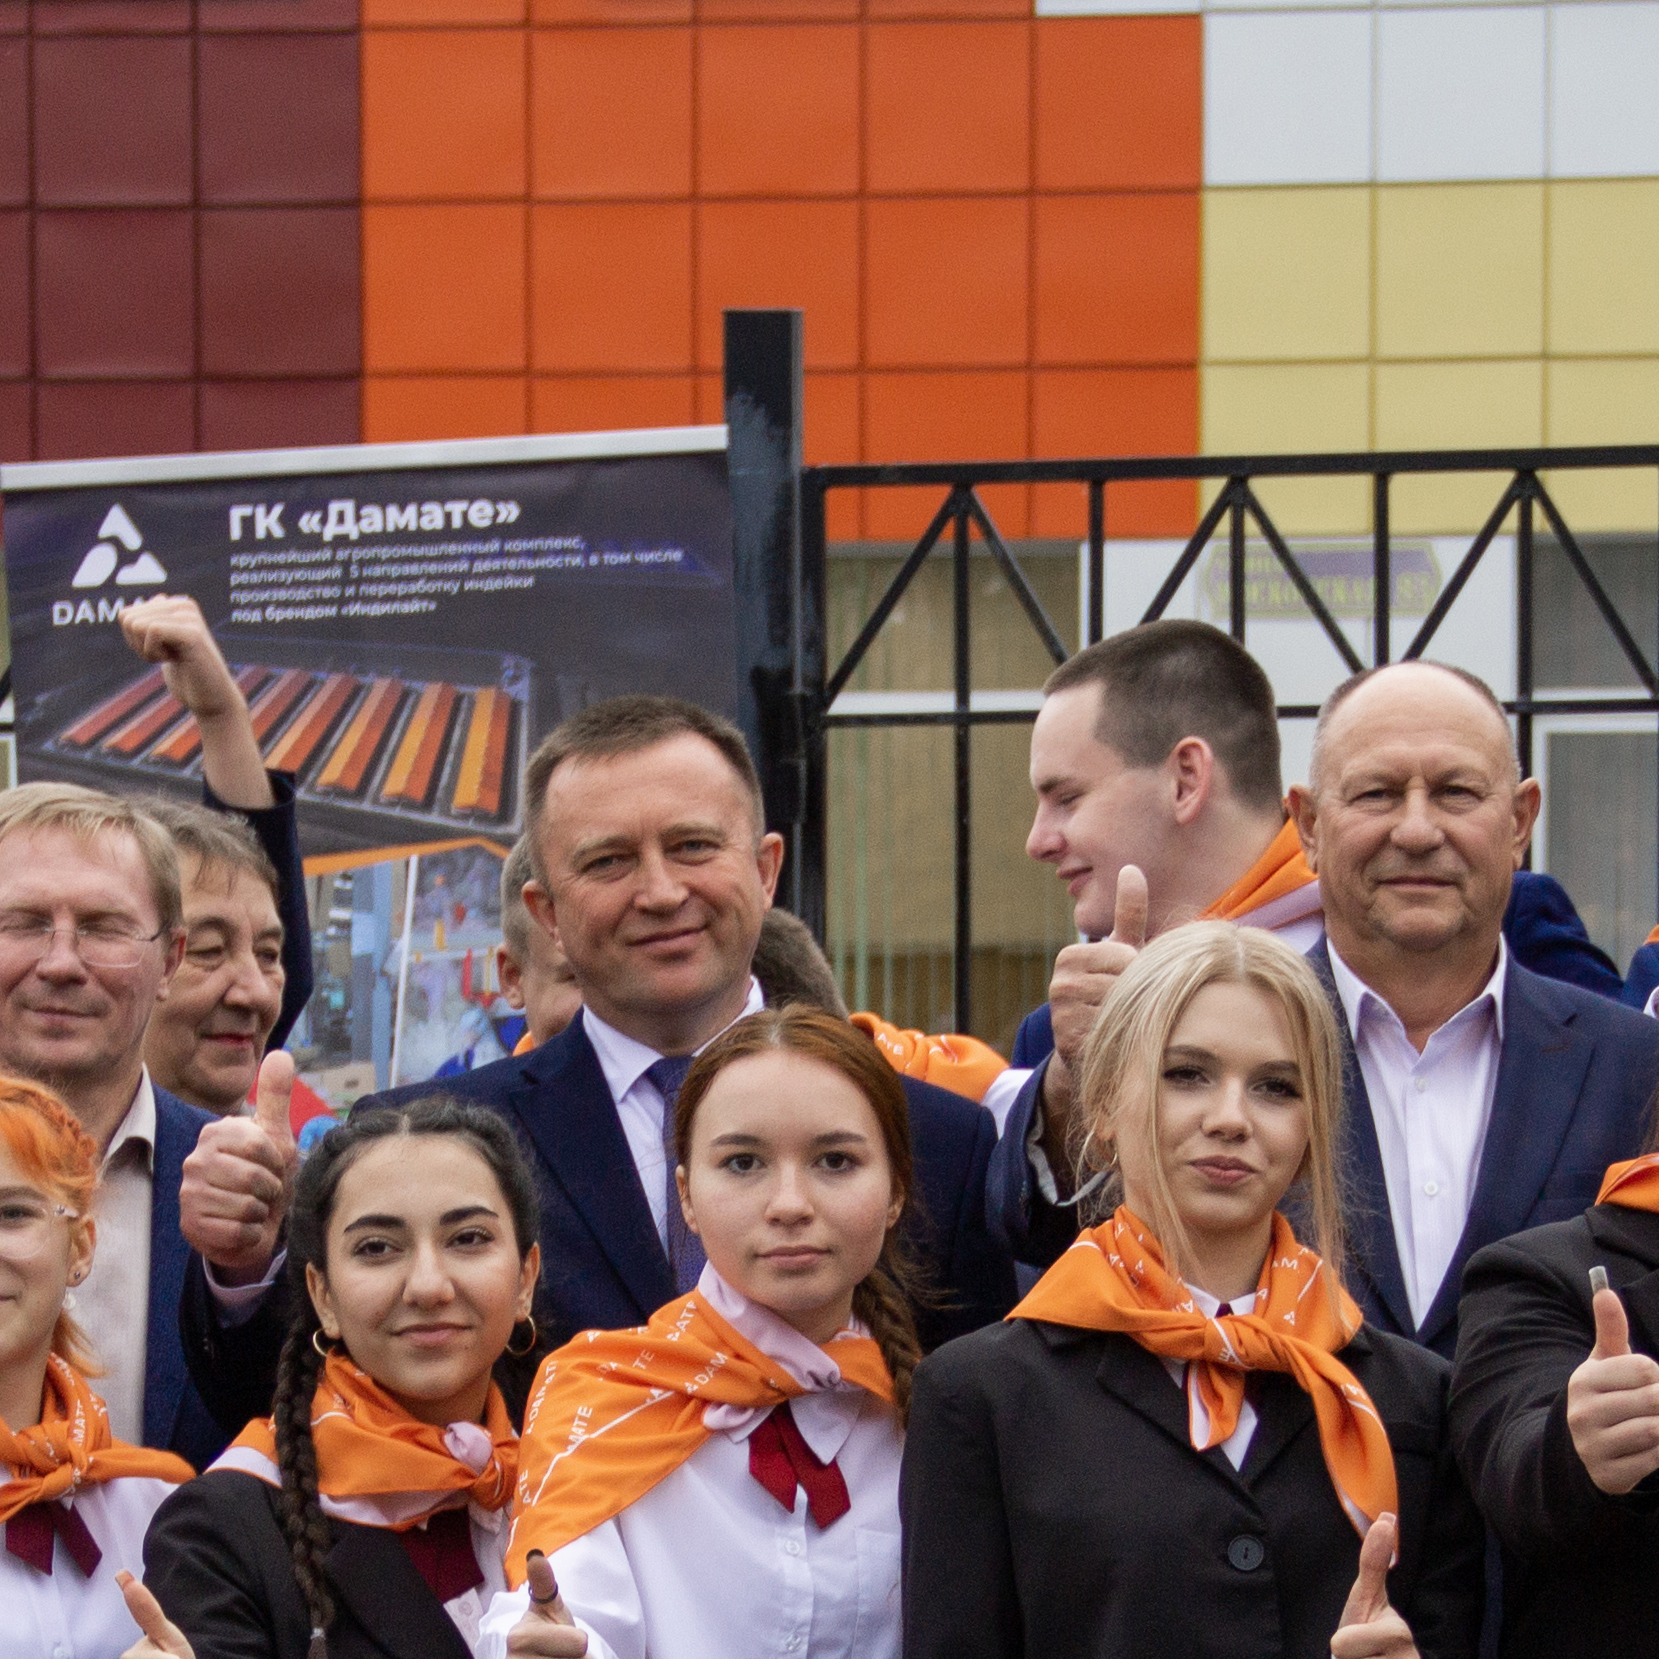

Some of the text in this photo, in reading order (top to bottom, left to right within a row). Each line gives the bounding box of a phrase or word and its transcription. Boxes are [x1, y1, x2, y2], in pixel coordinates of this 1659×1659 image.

[229, 498, 522, 542] ГК «Дамате»
[230, 536, 586, 568] крупнейший агропромышленный комплекс,
[230, 549, 684, 586] реализующий 5 направлений деятельности, в том числе
[230, 574, 535, 603] производство и переработку индейки
[231, 599, 437, 623] под брендом «Индилайт»
[695, 1352, 729, 1386] DAM
